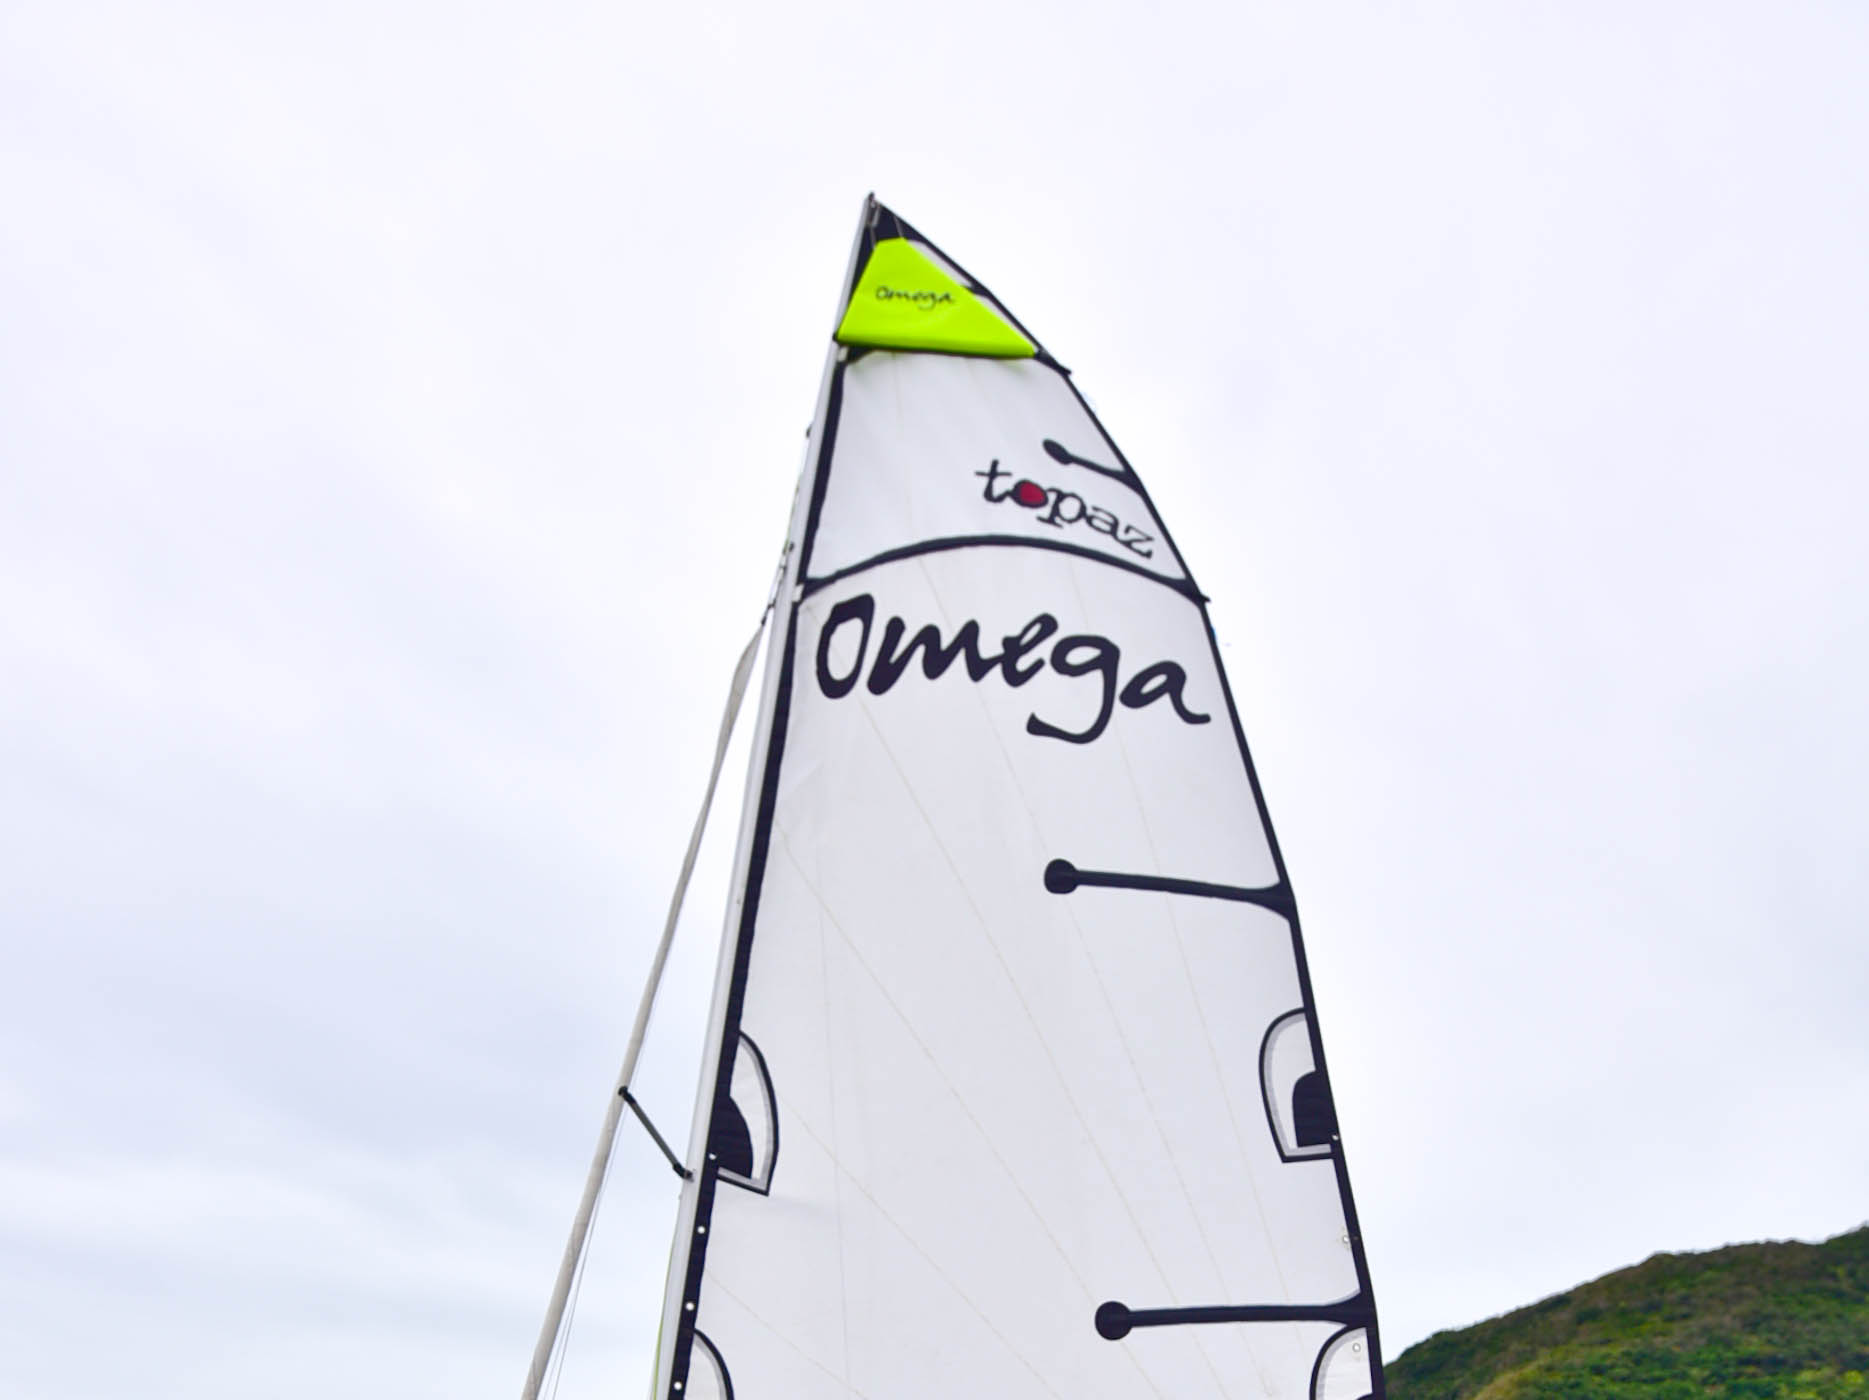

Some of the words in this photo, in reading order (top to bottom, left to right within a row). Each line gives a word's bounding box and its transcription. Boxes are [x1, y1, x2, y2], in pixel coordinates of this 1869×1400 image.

[875, 285, 955, 312] Omega
[974, 459, 1154, 559] topaz
[816, 593, 1212, 744] Omega
